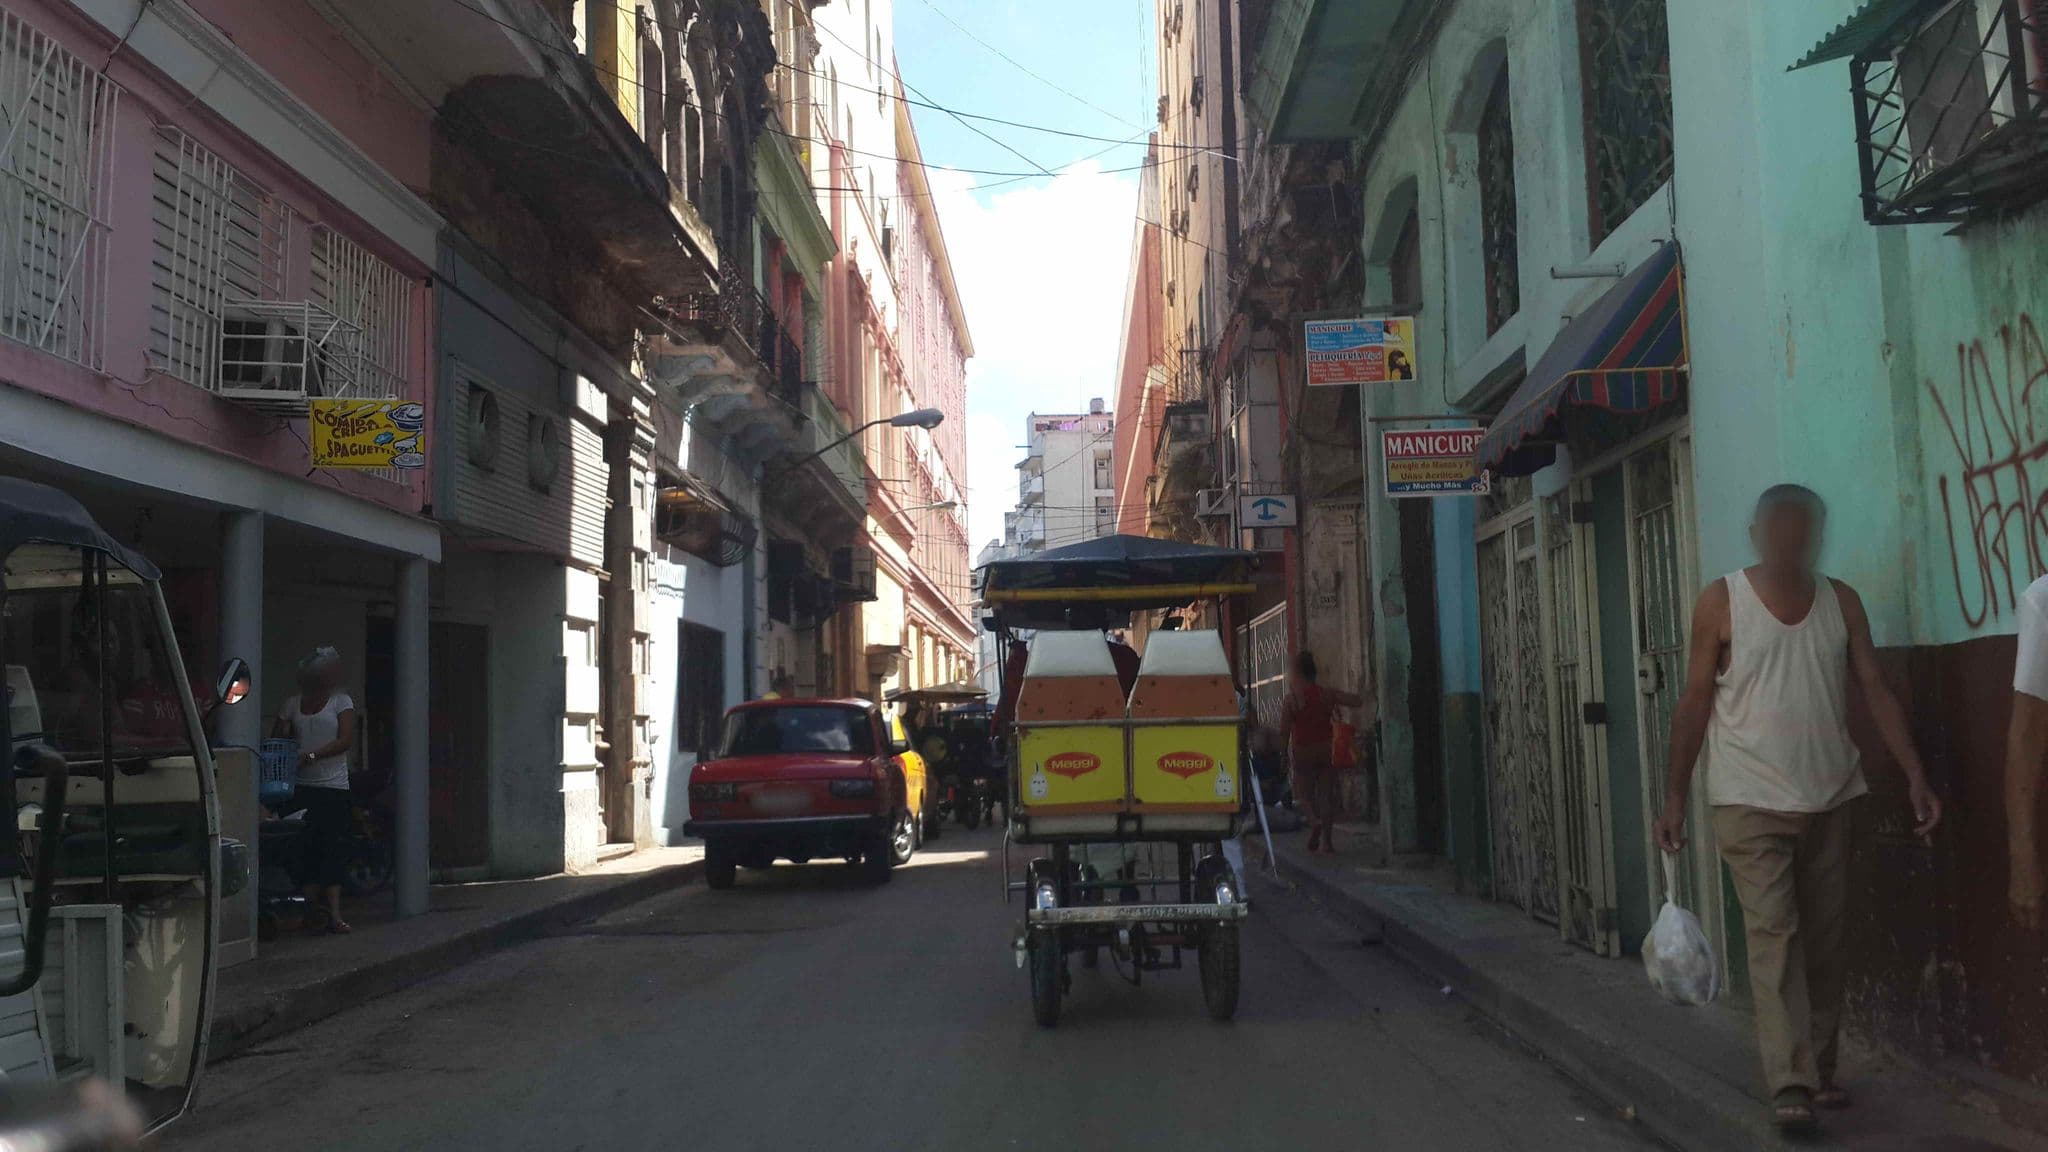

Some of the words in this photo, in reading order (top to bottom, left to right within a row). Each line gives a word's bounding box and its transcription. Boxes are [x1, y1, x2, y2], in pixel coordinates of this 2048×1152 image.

[314, 408, 379, 430] COMIDA
[1413, 482, 1442, 490] Mucho
[1051, 758, 1094, 770] Maggi
[1164, 758, 1207, 770] Maggi
